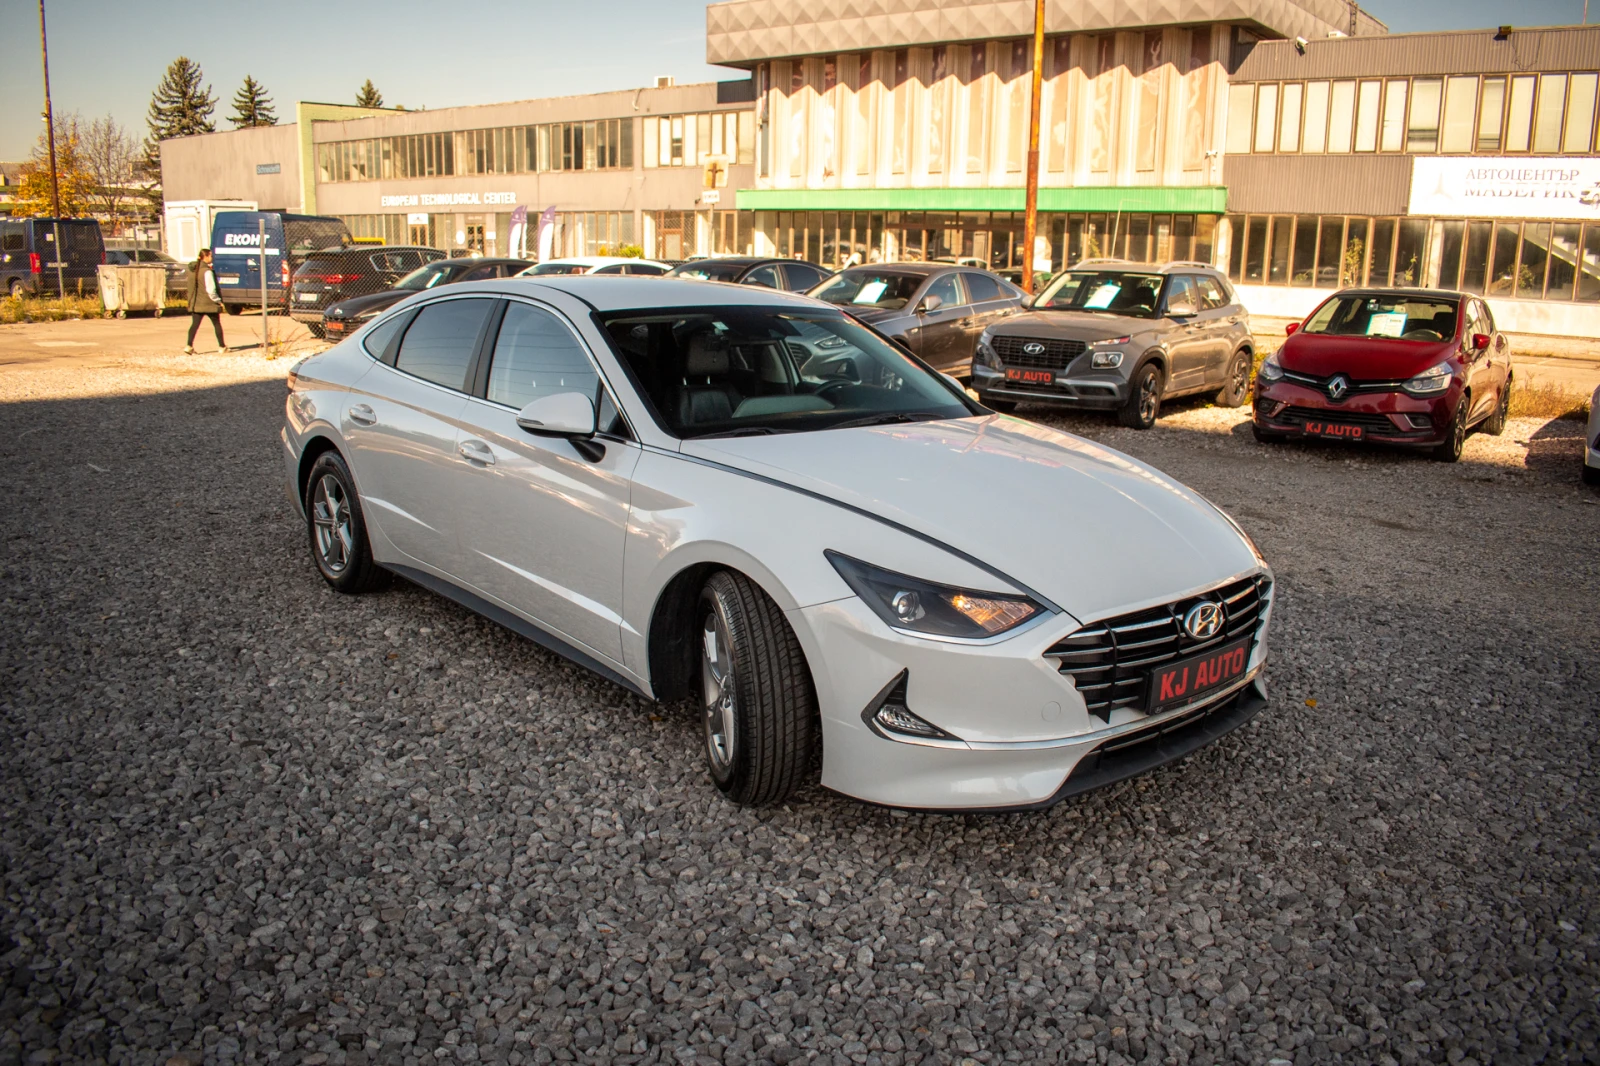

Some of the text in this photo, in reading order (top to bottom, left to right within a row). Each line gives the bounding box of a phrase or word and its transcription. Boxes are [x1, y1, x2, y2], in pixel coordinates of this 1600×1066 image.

[1465, 168, 1580, 182] АВТОЦЕНТЪР
[381, 192, 517, 206] EUROPEAN TECHNOLOGICAL CENTER
[1008, 369, 1052, 382] KJ AUTO
[1305, 422, 1322, 433] KJ
[1325, 424, 1362, 437] AUTO
[1159, 667, 1189, 701] KJ
[1194, 647, 1245, 690] AUTO
